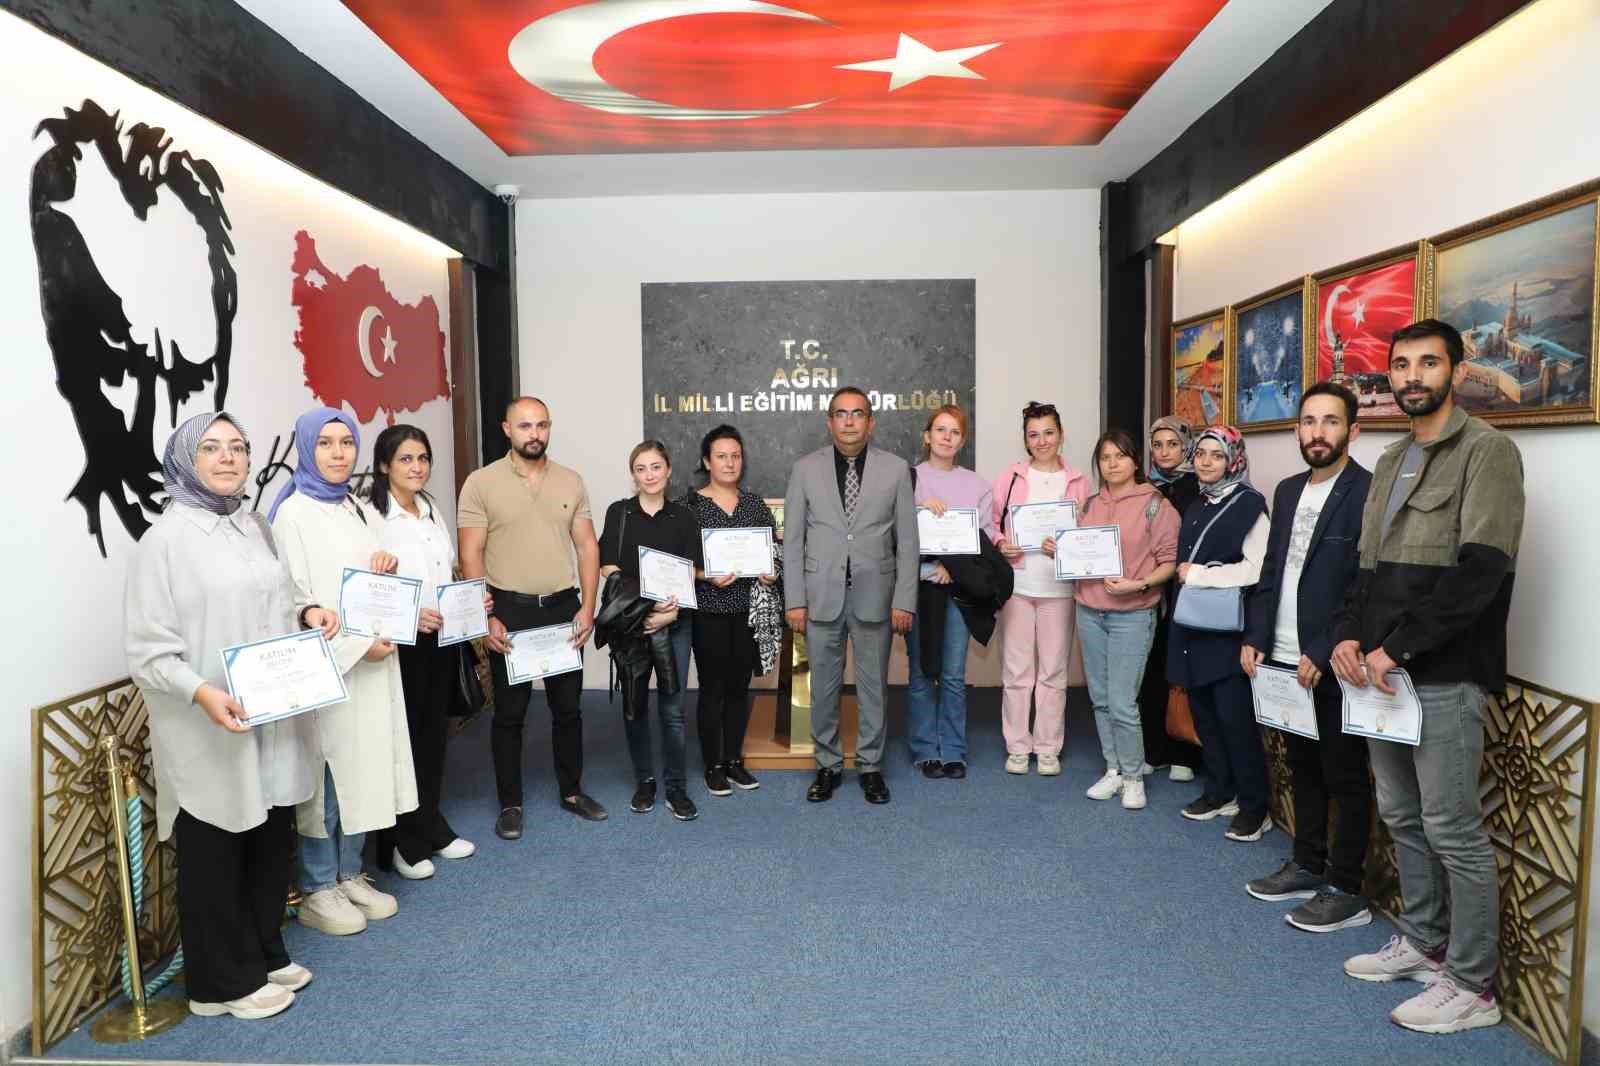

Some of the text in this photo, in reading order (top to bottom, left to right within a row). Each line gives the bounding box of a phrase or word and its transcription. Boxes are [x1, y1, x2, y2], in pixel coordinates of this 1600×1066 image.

[780, 340, 829, 361] T.C.
[770, 363, 838, 389] AĞRI
[654, 390, 958, 412] İL MİLLİ EĞİTİM MÜRLÜĞÜ
